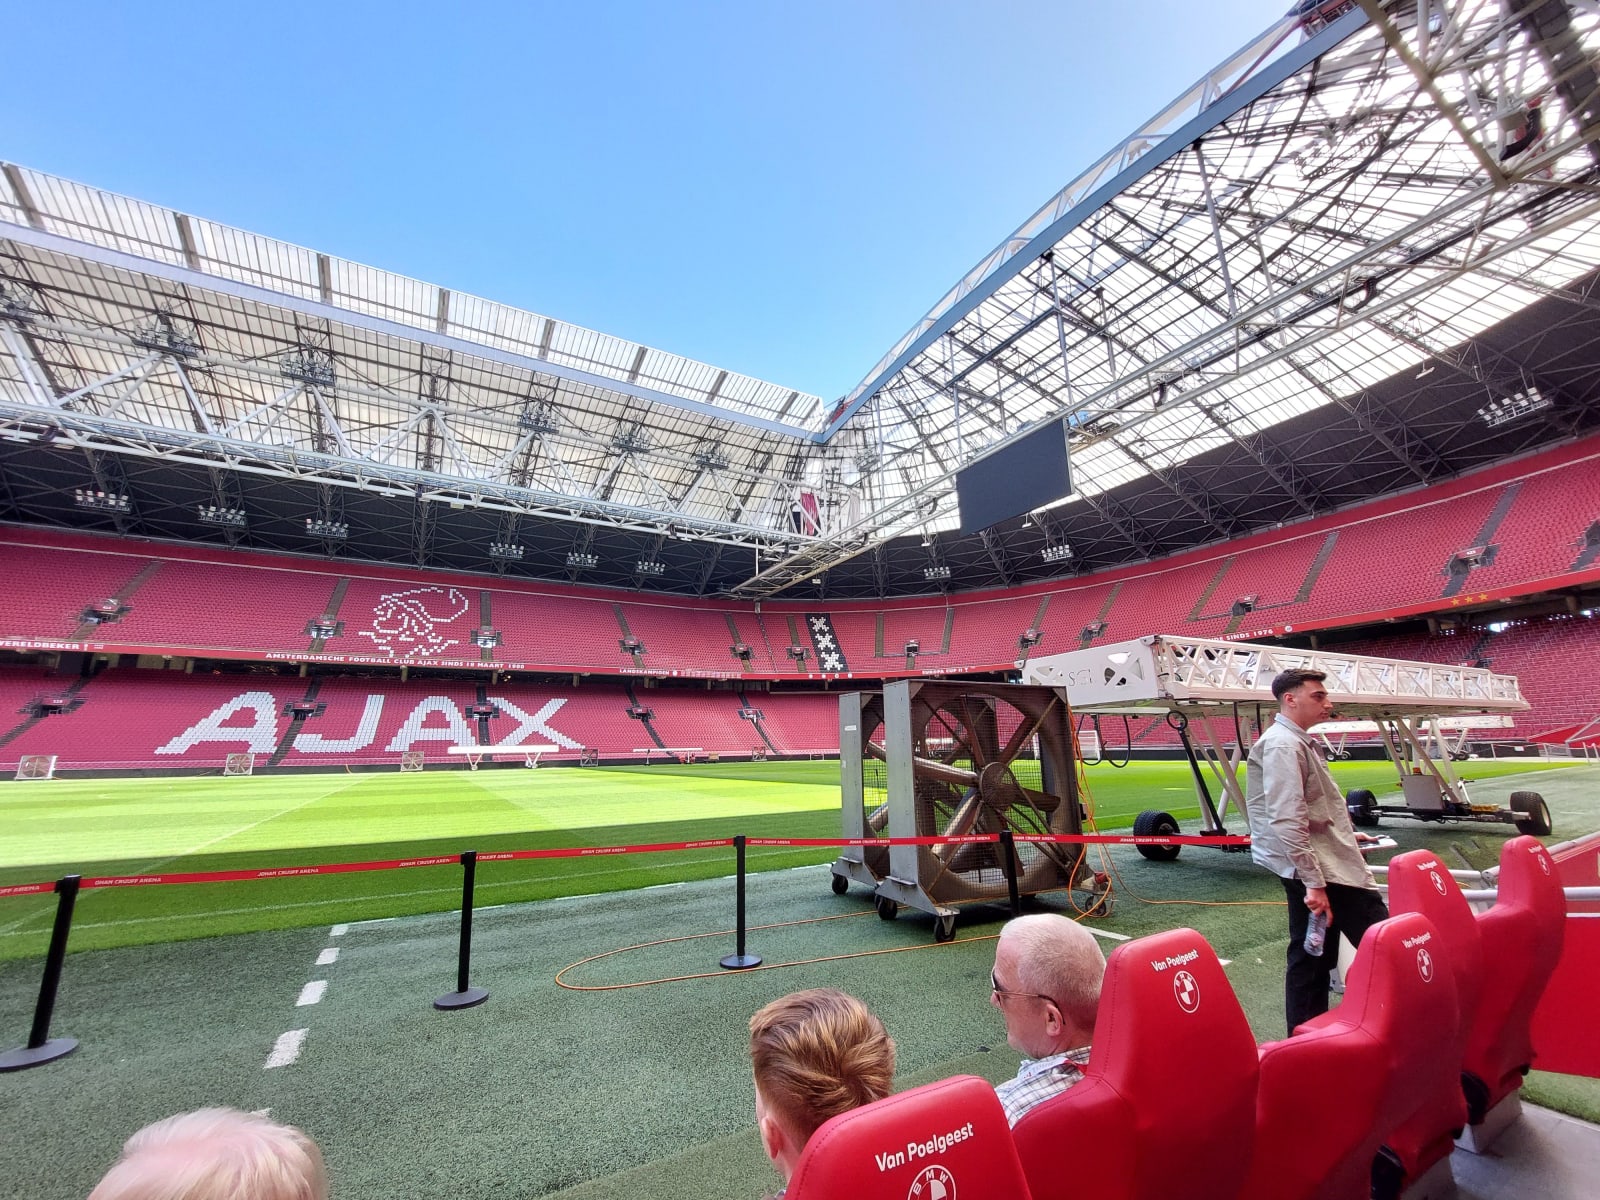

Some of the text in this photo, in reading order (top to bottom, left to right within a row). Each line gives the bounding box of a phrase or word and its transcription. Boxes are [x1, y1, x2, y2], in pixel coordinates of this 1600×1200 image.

[1226, 632, 1250, 641] SINDS
[1253, 628, 1273, 637] 1976
[265, 653, 344, 662] AMSTERDAMSCHE
[349, 656, 391, 664] FOOTBALL
[154, 691, 586, 757] AJAX
[1151, 949, 1199, 972] Van Poelgeest
[875, 1122, 974, 1172] Van Poelgeest
[913, 1169, 949, 1195] BMW
